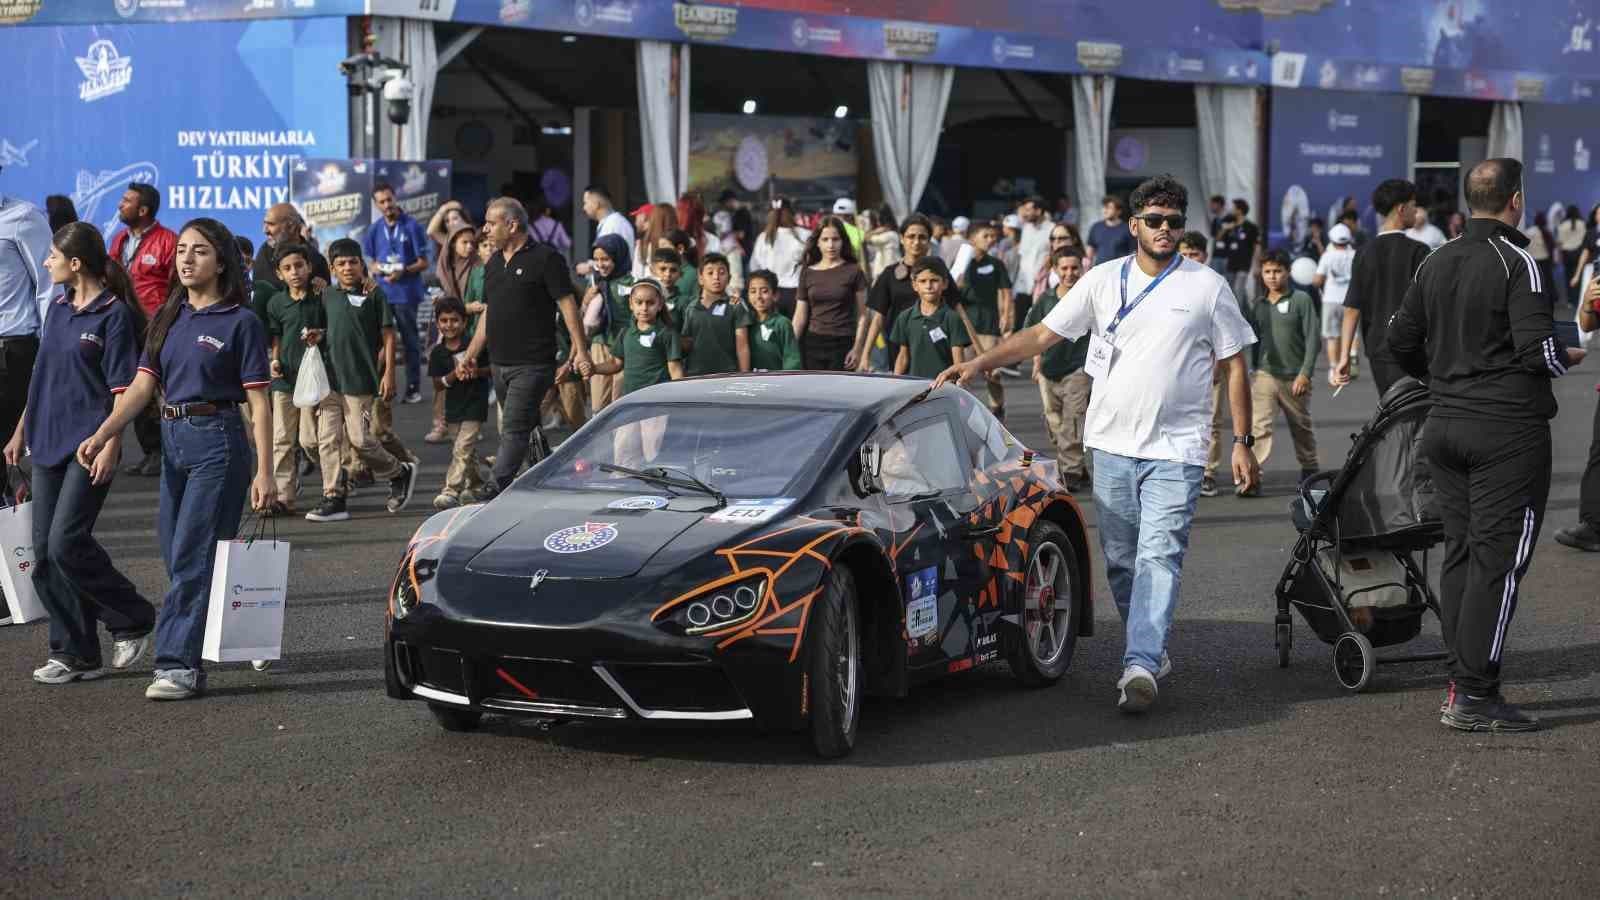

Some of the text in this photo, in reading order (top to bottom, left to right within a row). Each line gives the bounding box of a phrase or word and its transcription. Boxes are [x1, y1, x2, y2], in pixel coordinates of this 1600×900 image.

[178, 129, 316, 147] DEV YATIRIMLARLA
[304, 193, 363, 217] TEKNOFEST
